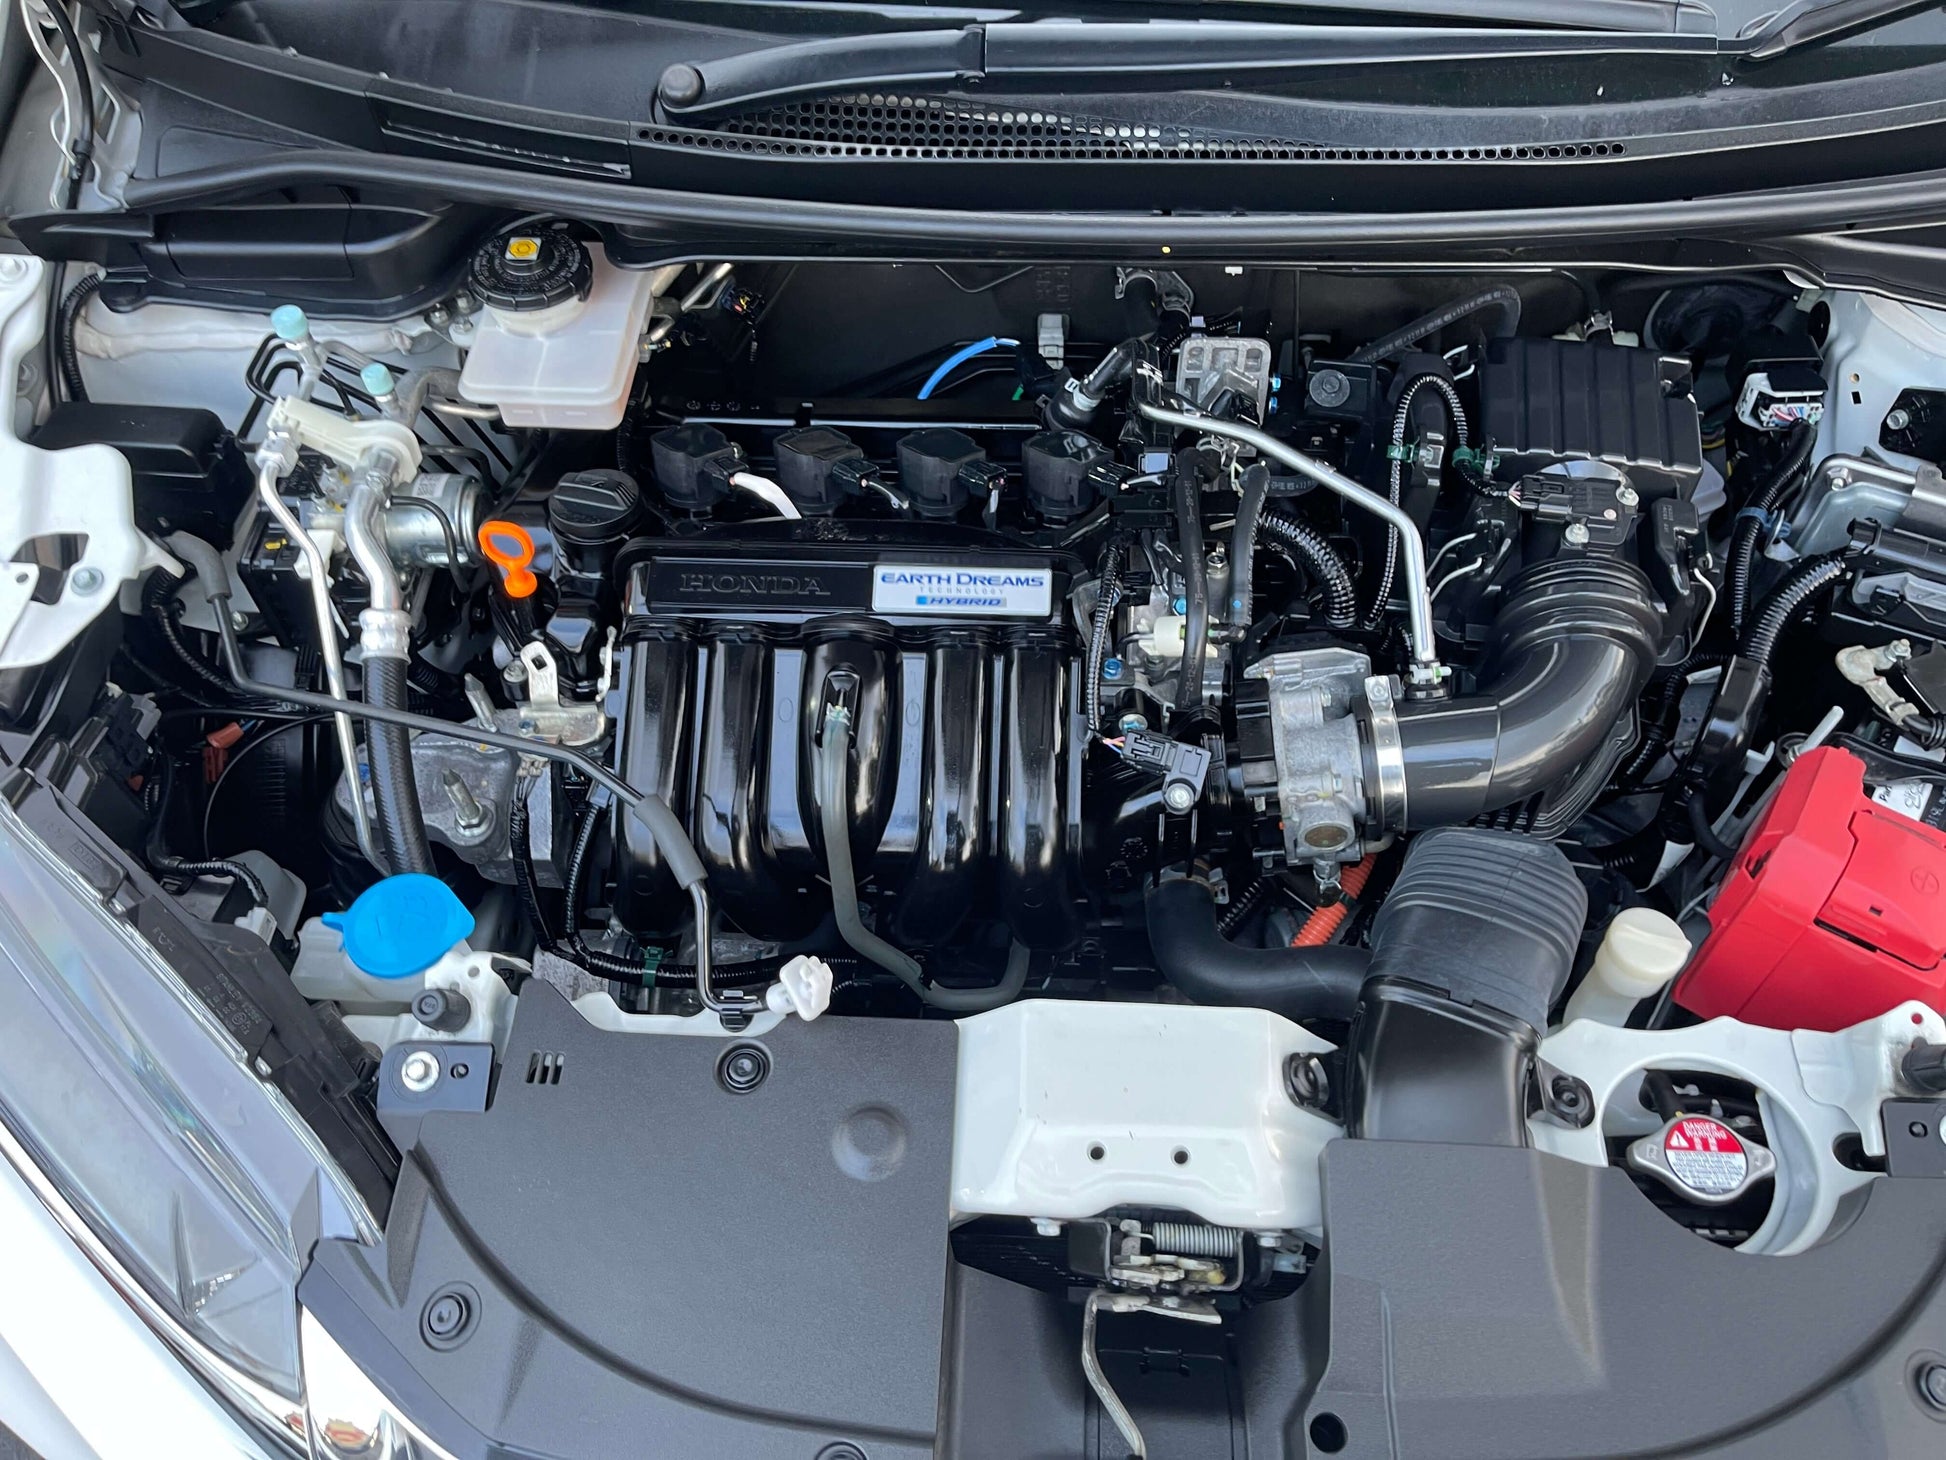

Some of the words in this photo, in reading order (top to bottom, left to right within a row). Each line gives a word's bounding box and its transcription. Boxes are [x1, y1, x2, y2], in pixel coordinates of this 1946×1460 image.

[680, 573, 831, 595] HONDA
[881, 572, 950, 585] EARTH
[956, 572, 1044, 587] DREAMS
[919, 586, 1004, 595] TECHNOLOGY
[929, 597, 1001, 606] HYBRID
